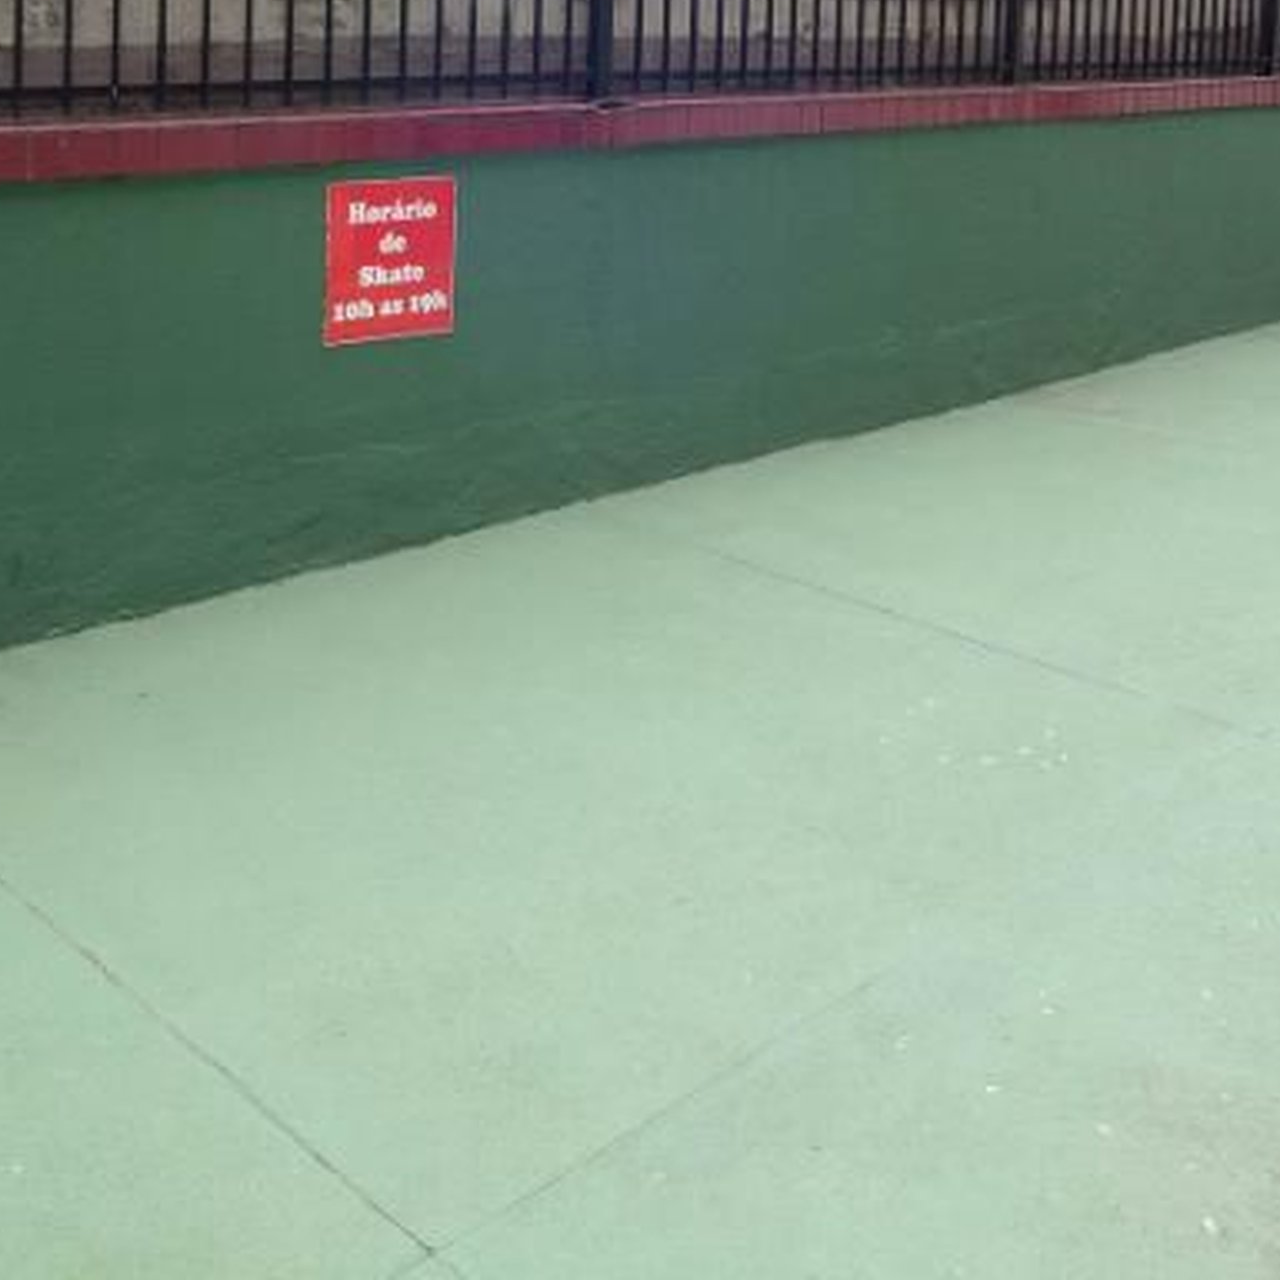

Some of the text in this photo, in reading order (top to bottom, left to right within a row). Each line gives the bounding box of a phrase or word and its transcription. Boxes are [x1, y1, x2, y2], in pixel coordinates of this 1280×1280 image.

[349, 200, 437, 224] Horário
[379, 233, 407, 253] de
[359, 265, 424, 286] Skate
[333, 290, 447, 321] 10h as 19h
